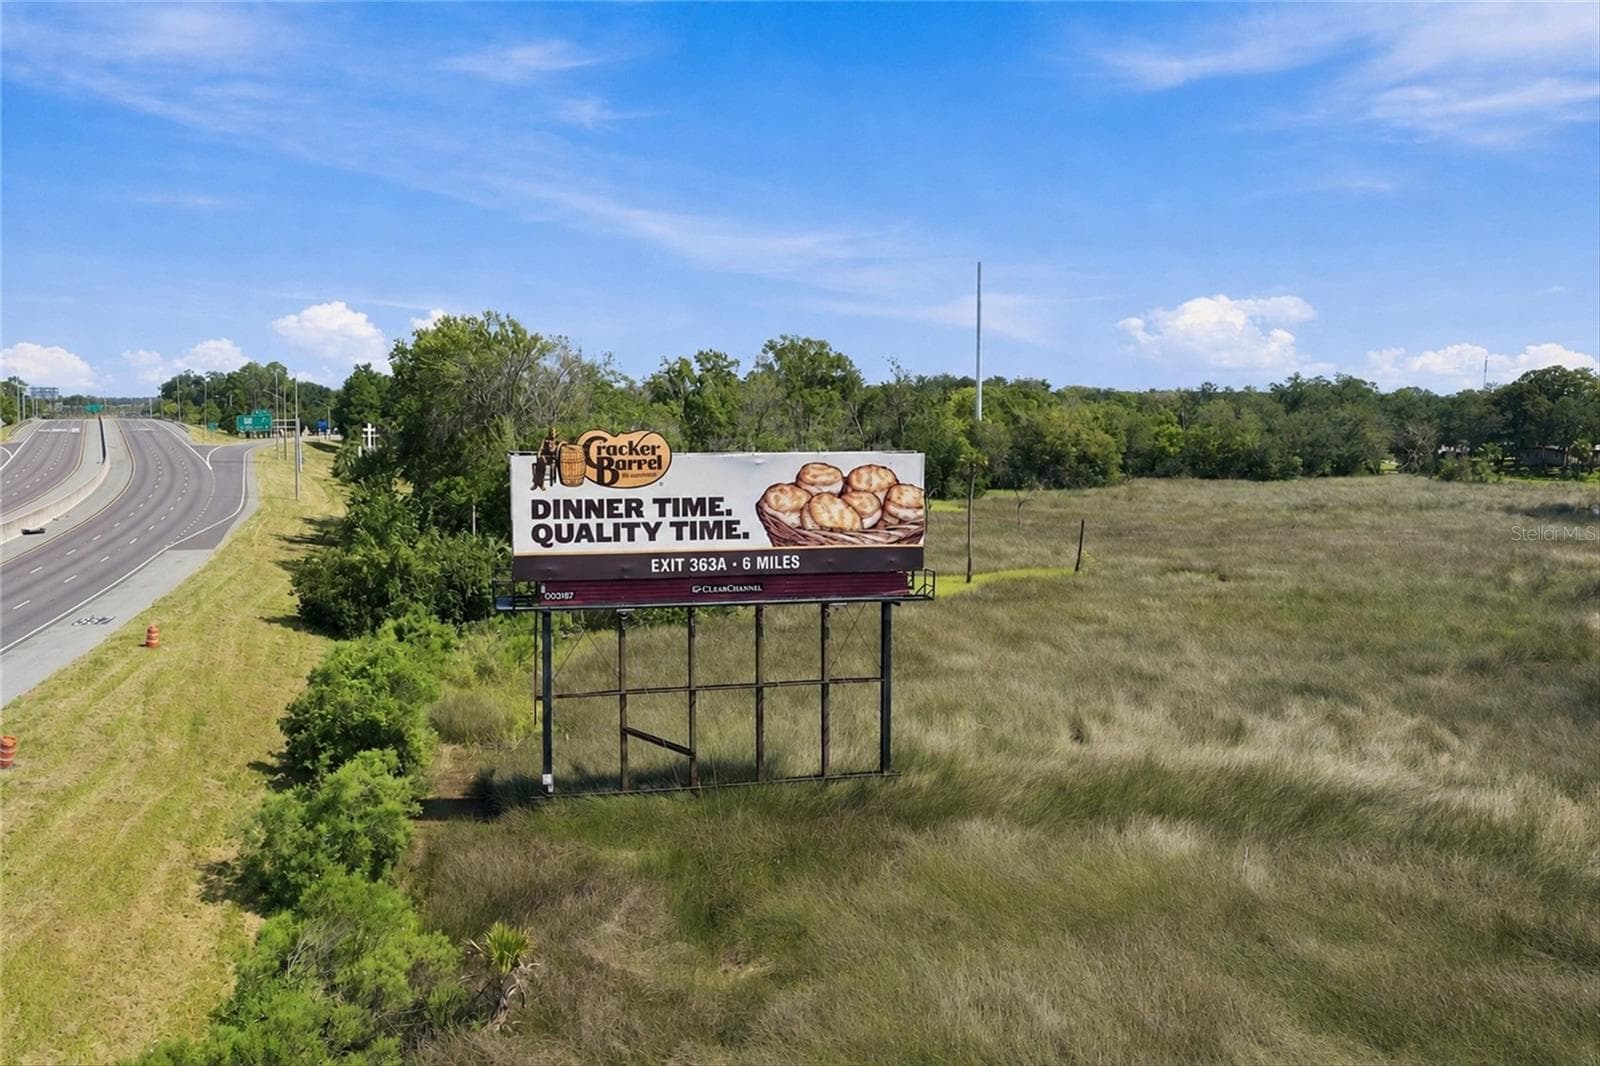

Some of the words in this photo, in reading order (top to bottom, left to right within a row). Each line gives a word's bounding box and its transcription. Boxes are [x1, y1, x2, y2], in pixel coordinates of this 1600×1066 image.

[583, 436, 661, 469] Cracker
[597, 455, 662, 485] Barrel
[531, 498, 644, 520] DINNER
[653, 497, 733, 518] TIME.
[531, 521, 663, 548] QUALITY
[670, 520, 750, 541] TIME.
[651, 558, 685, 572] EXIT
[690, 557, 727, 571] 363A
[742, 557, 751, 570] 6
[757, 555, 800, 569] MILES
